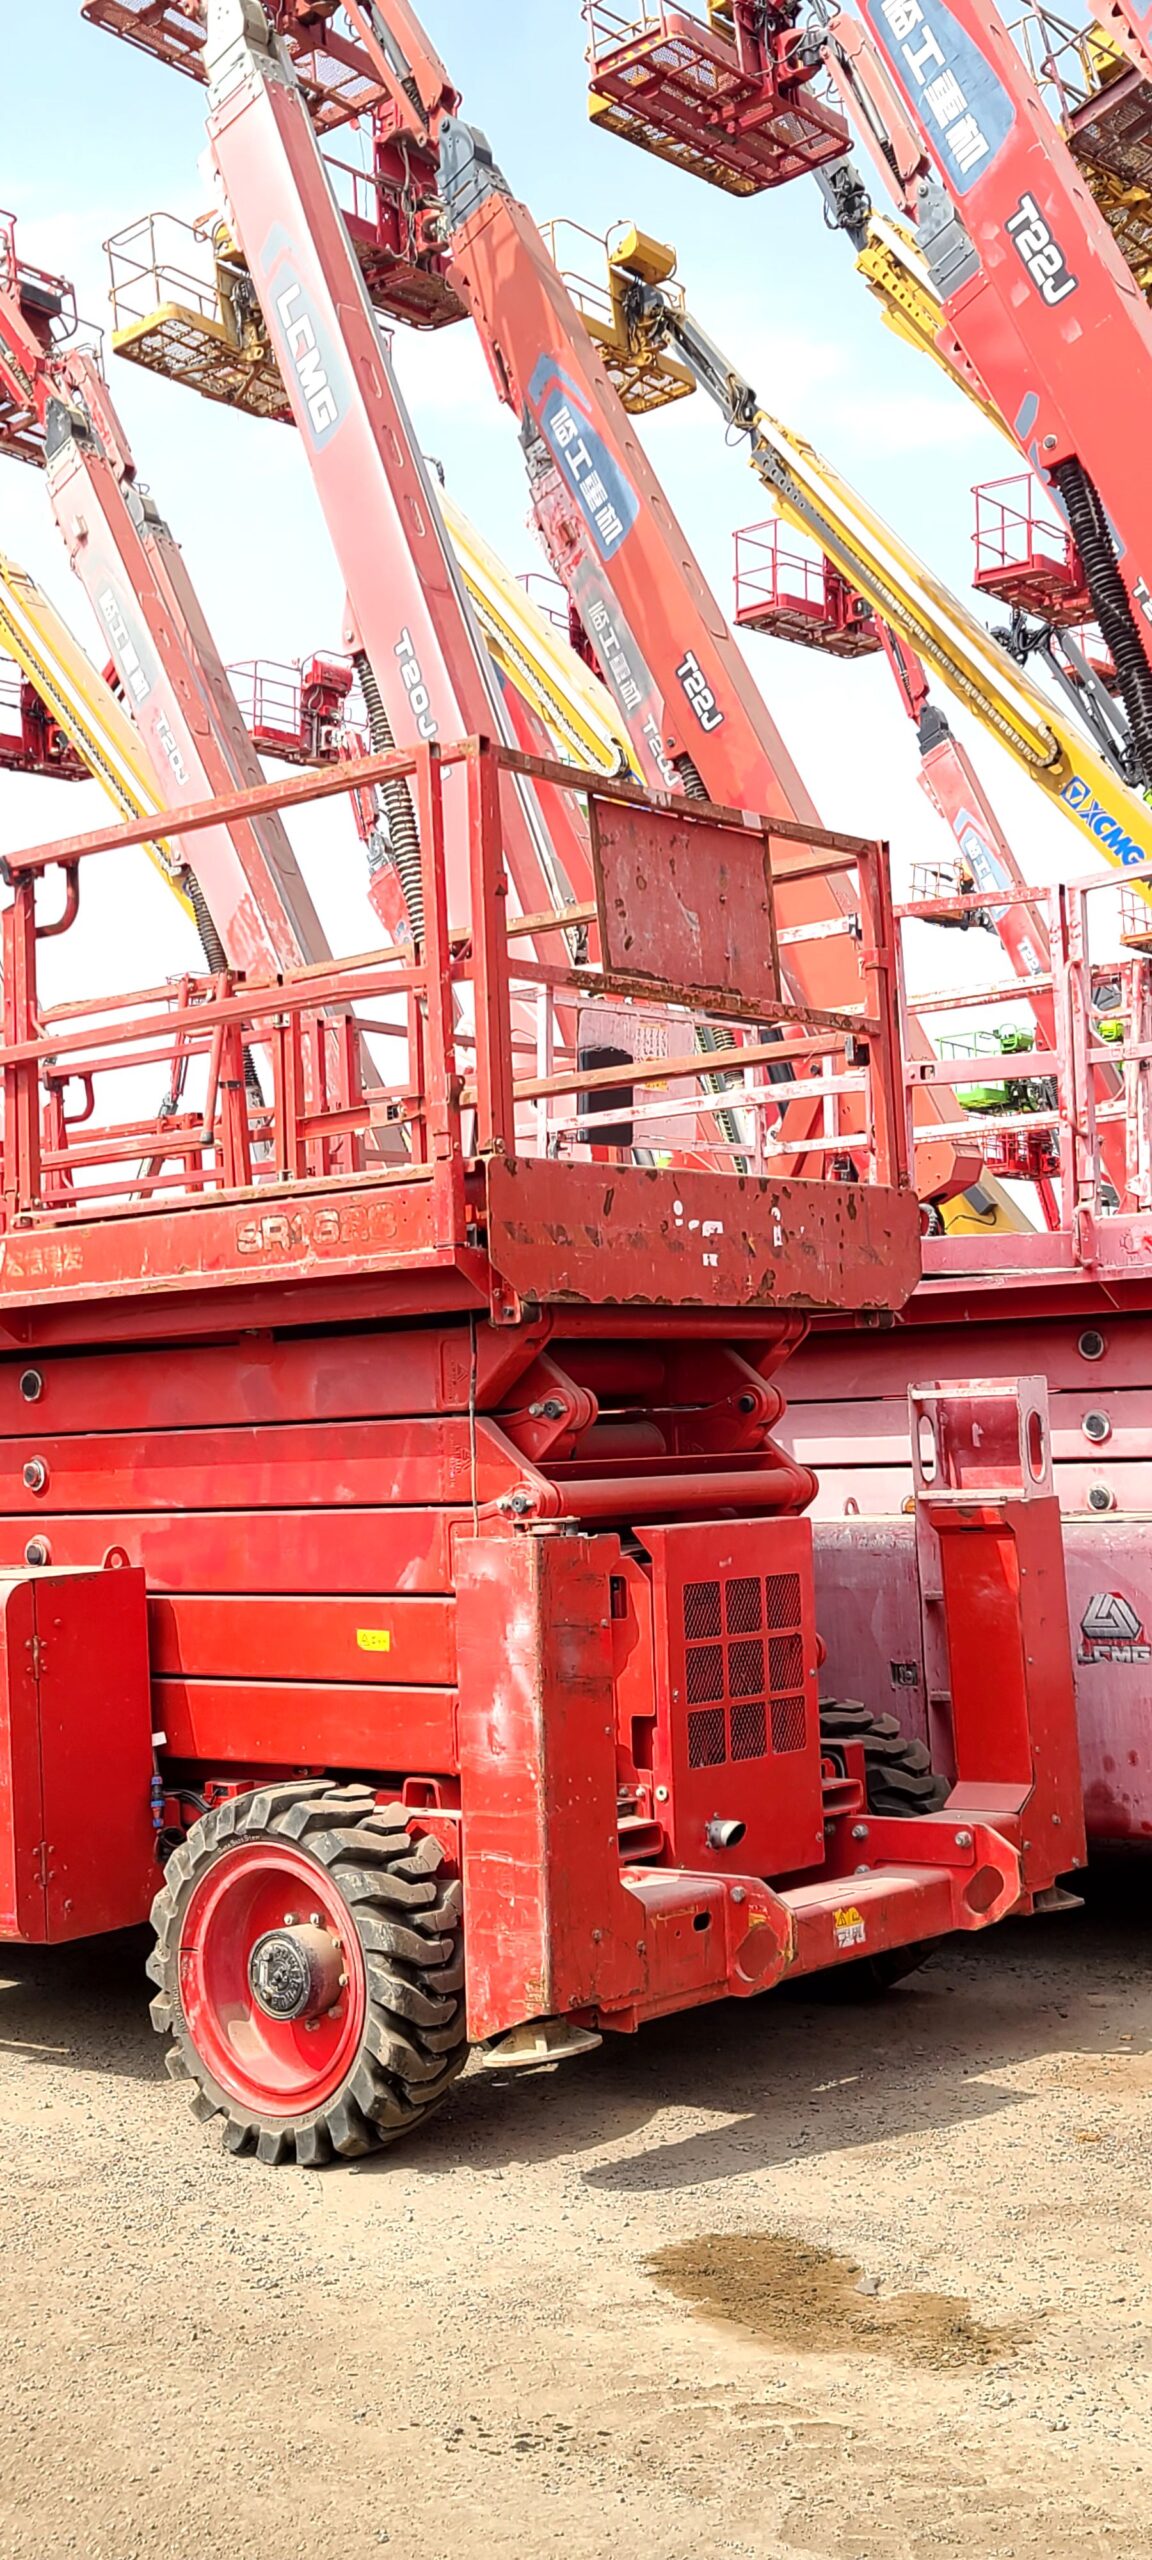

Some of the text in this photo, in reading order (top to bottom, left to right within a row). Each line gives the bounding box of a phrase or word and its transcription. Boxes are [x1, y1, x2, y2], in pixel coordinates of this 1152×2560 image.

[1006, 193, 1078, 305] T22J
[550, 406, 624, 546] 临工重机
[588, 599, 642, 711] 临工重机
[677, 651, 724, 732] T22J
[156, 709, 190, 787] T20J
[1077, 798, 1145, 866] XCMG
